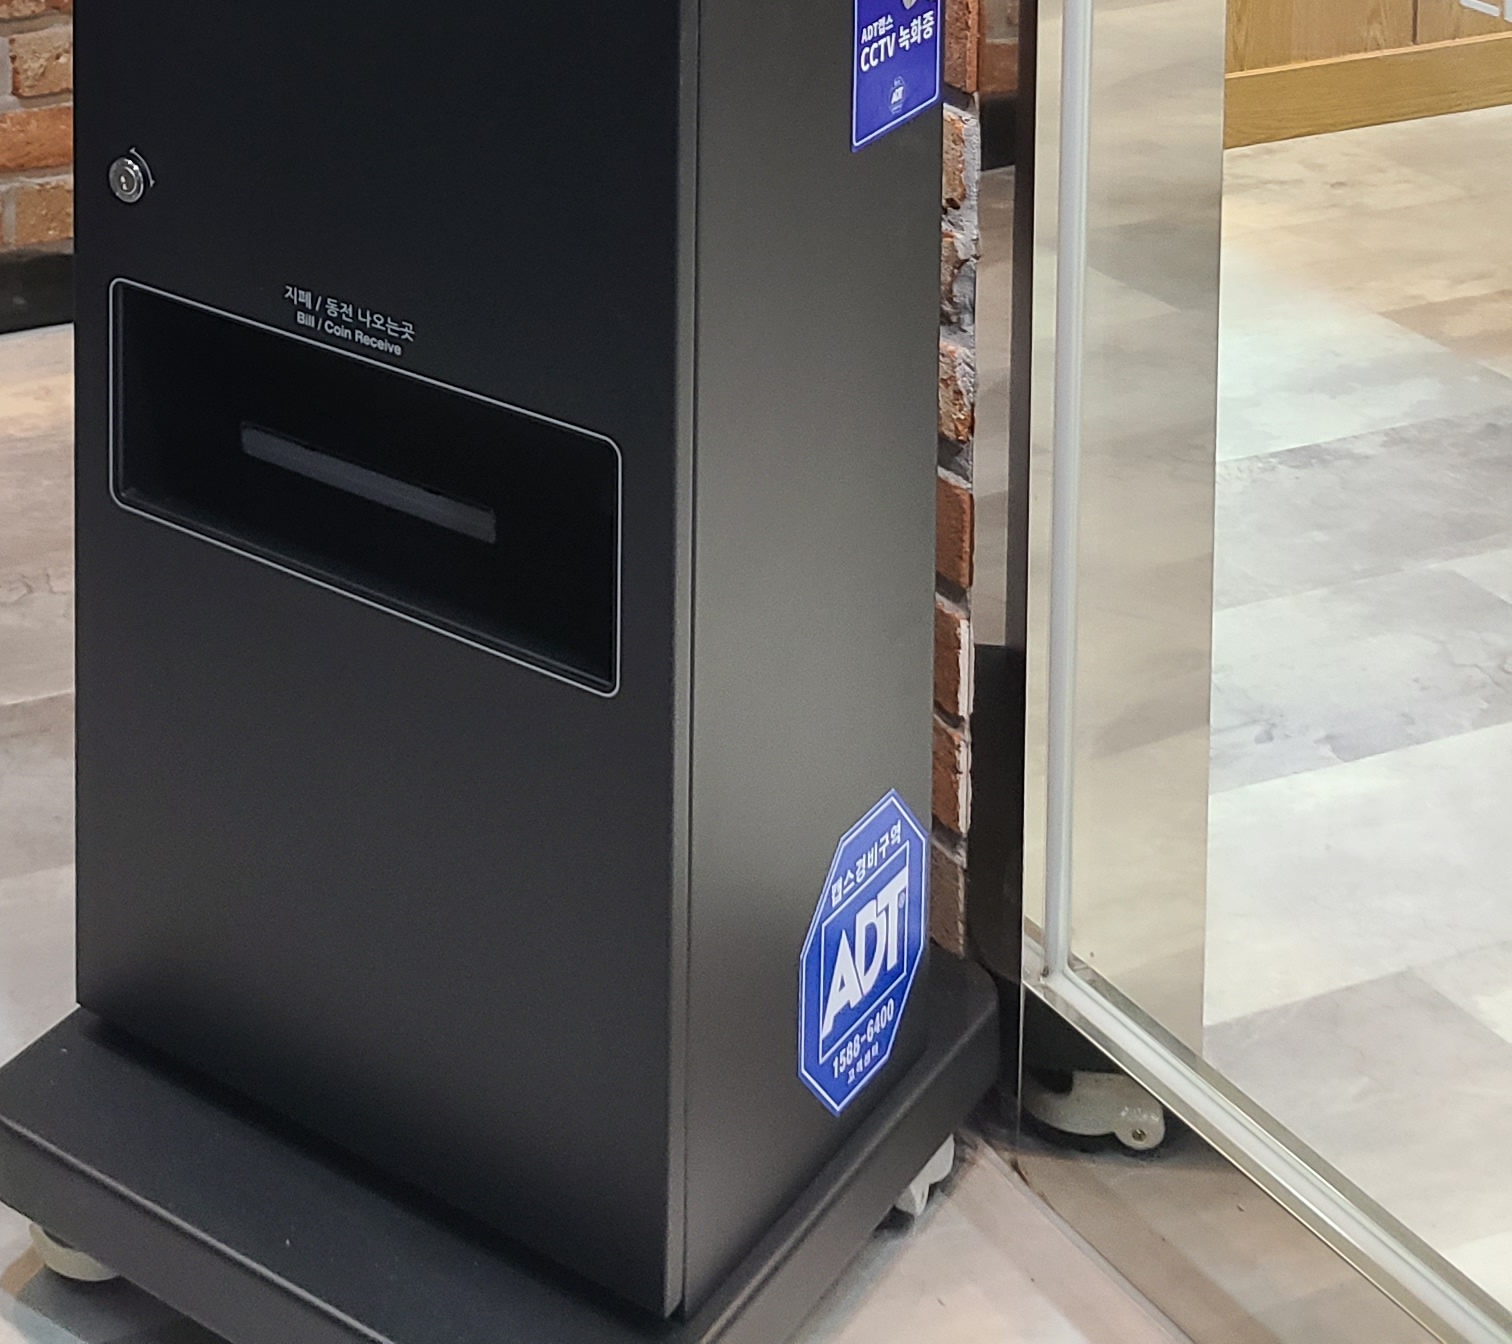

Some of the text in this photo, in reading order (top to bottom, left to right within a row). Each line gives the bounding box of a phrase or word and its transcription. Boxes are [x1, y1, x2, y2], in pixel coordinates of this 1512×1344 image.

[860, 11, 935, 73] CCTV 녹화중
[284, 285, 416, 343] 지폐 동전 나오는곳
[296, 311, 403, 356] Bill Coin Receive
[821, 864, 908, 1040] ADT
[832, 998, 895, 1079] 1588-6400
